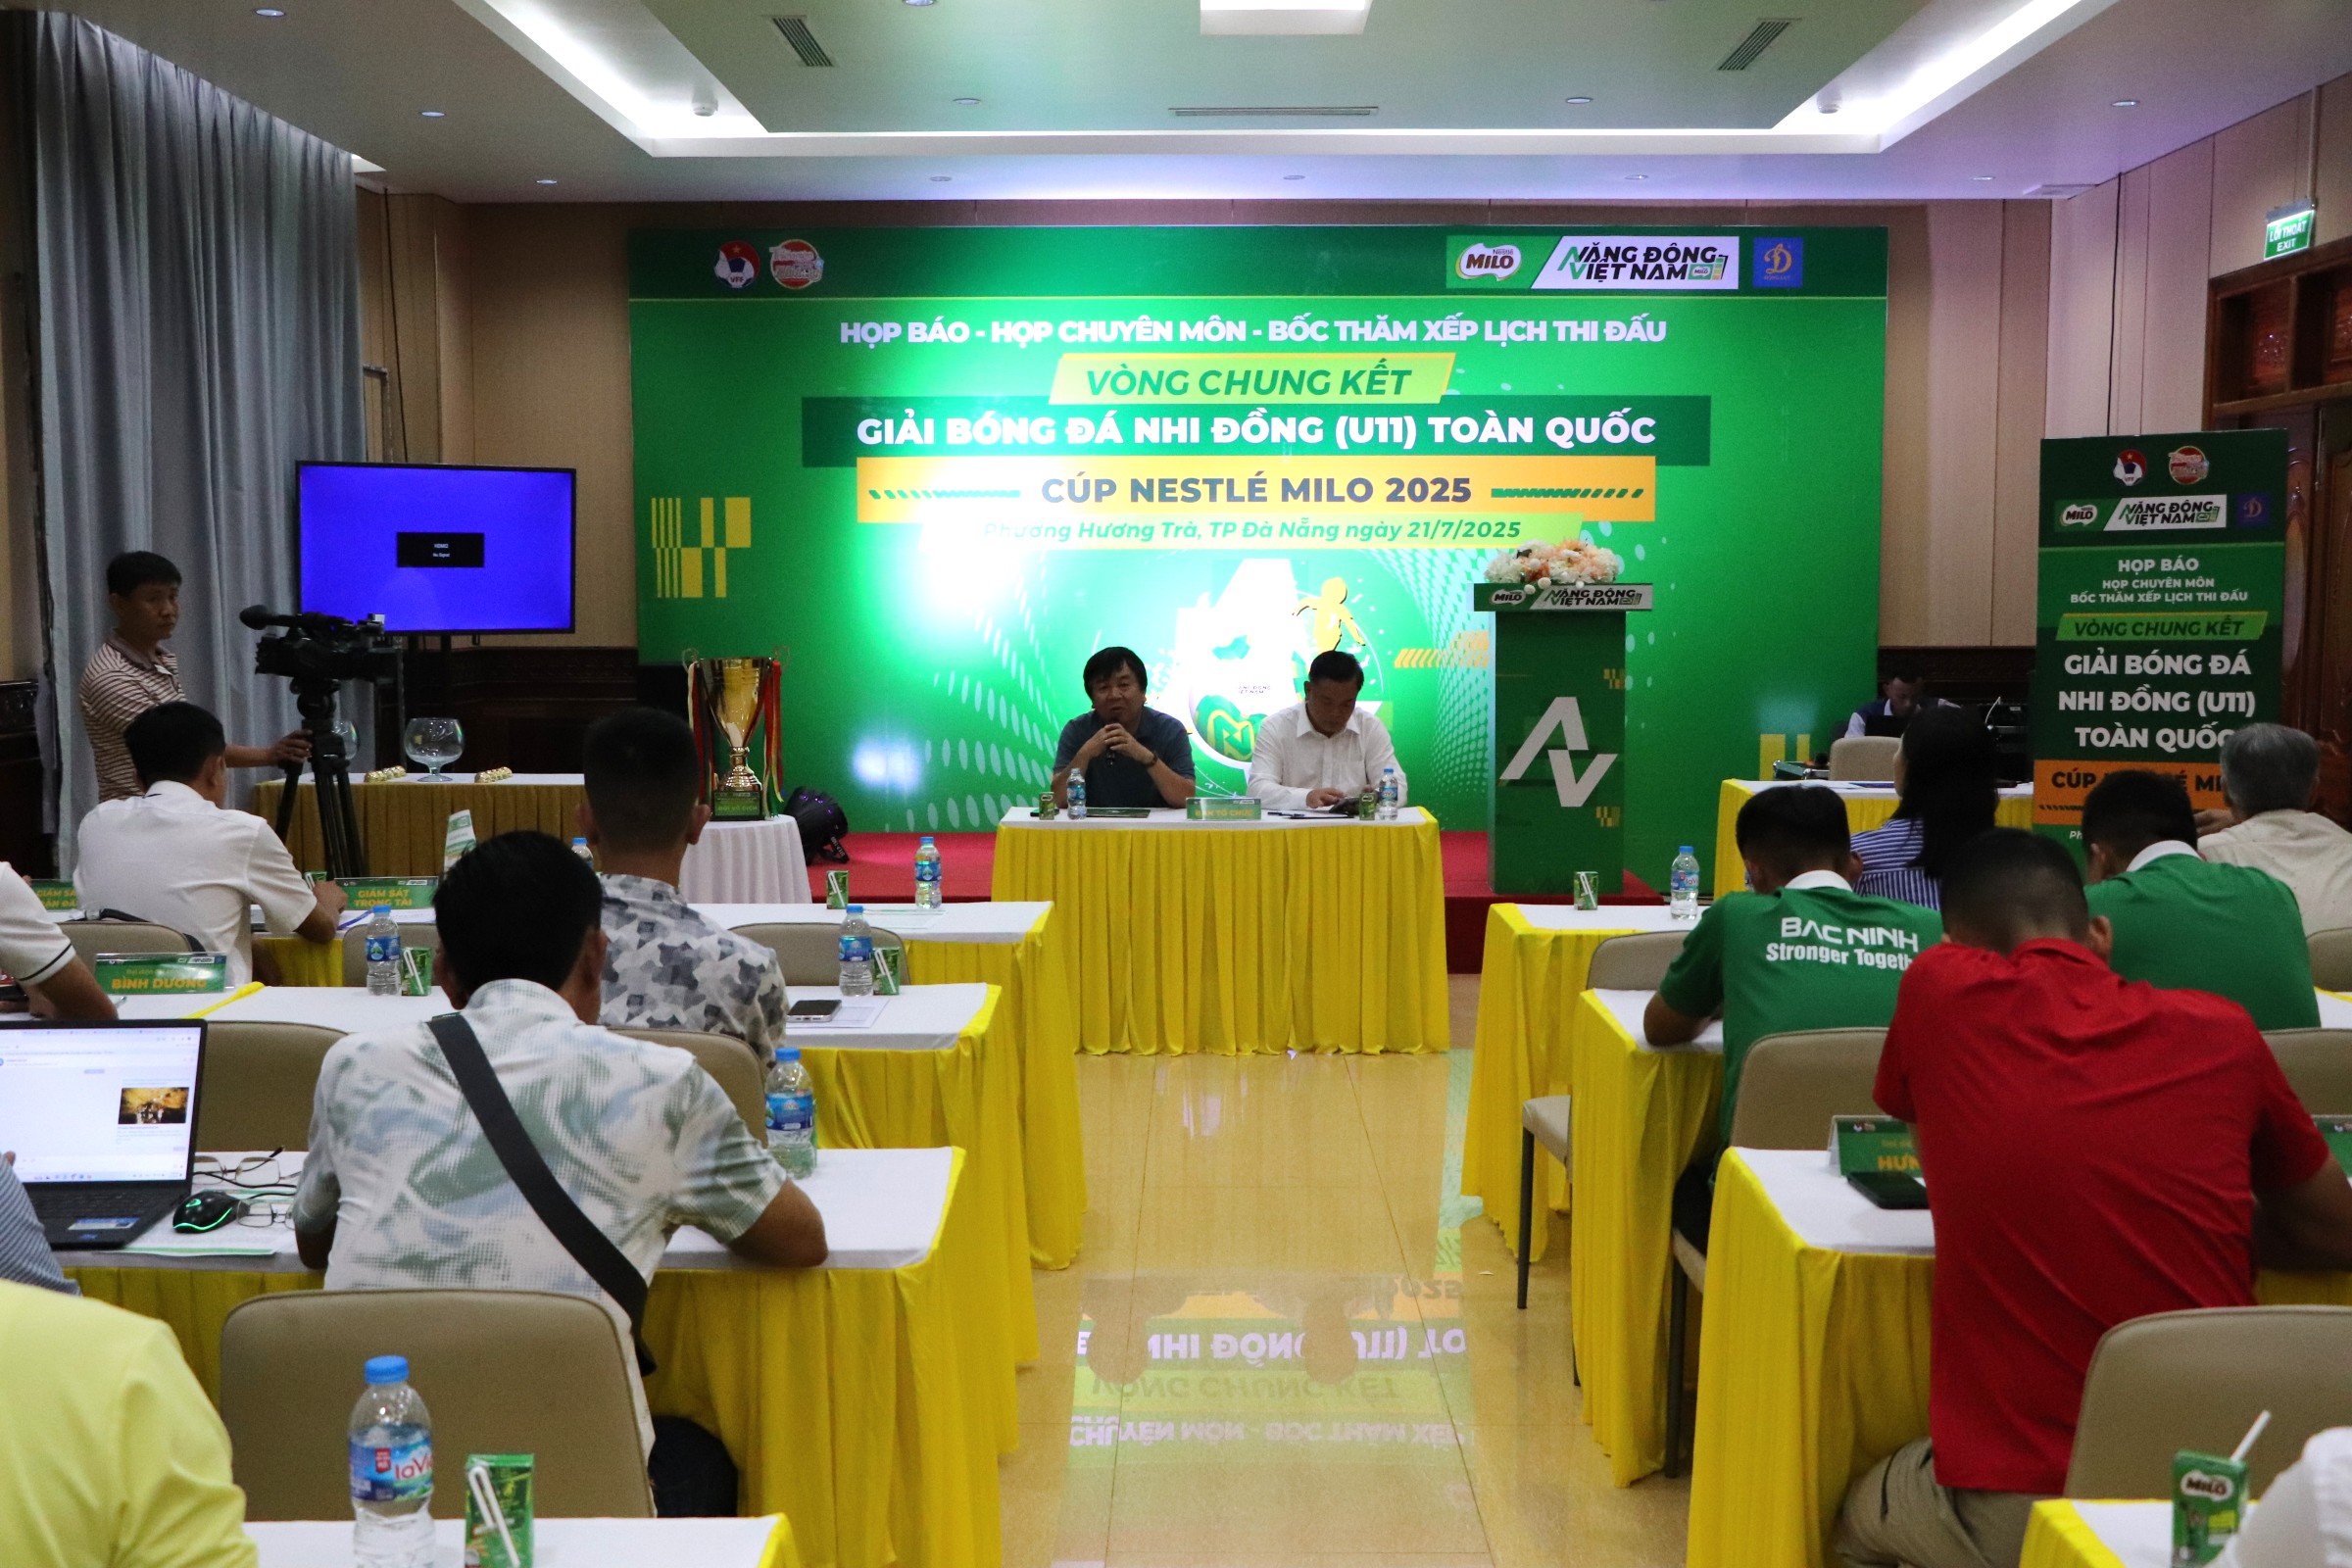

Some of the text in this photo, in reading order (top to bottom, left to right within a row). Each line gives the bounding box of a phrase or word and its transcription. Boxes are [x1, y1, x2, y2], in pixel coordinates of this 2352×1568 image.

[2277, 238, 2296, 252] EXIT
[1466, 254, 1514, 270] MILO
[1630, 263, 1689, 280] NAM
[841, 321, 902, 348] HỌP
[907, 317, 970, 343] BÁO
[991, 321, 1053, 349] HỌP
[1058, 315, 1173, 342] CHUYÊN
[1179, 315, 1246, 342] MÔN
[1269, 313, 1329, 342] BỐC
[1334, 315, 1417, 341] THĂM
[1422, 313, 1478, 341] XẾP
[1485, 319, 1547, 348] LỊCH
[1553, 319, 1598, 341] THI
[1603, 313, 1667, 341] ĐẤU
[1086, 358, 1412, 396] VÒNG CHUNG KẾT
[857, 408, 1656, 450] GIẢI BÓNG ĐÁ NHI ĐỒNG (U11) TOÀN QUỐC
[1041, 470, 1472, 504] CÚP NESTLÉ MILO 2025
[2066, 510, 2093, 520] MILO
[2160, 512, 2195, 524] NAM
[1078, 522, 1155, 542] Hương
[1161, 521, 1201, 540] Trà,
[1208, 522, 1237, 538] TP
[1242, 521, 1273, 538] Đà
[1279, 517, 1339, 541] Nẵng
[1351, 520, 1402, 541] ngày
[1407, 519, 1521, 540] 21/7/2025
[2118, 555, 2199, 575] HỌP BÁO
[2102, 575, 2215, 591] HỌP CHUYÊN MÔN
[1494, 593, 1522, 602] MILO
[2071, 588, 2248, 605] BỐC THĂM XẾP LỊCH THI ĐẤU
[2075, 615, 2244, 636] VÒNG CHUNG KẾT
[2064, 647, 2252, 675] GIẢI BÓNG ĐÁ
[2059, 684, 2255, 717] NHI ĐỒNG (U11)
[2075, 722, 2149, 748] TOÀN
[2051, 767, 2096, 788] CÚP
[358, 888, 410, 898] GIÁM SÁT
[1846, 927, 1919, 953] NINH
[1766, 943, 1913, 971] Stronger Togeth
[112, 976, 207, 989] BÌNH DƯƠNG
[2186, 1477, 2228, 1495] MILO
